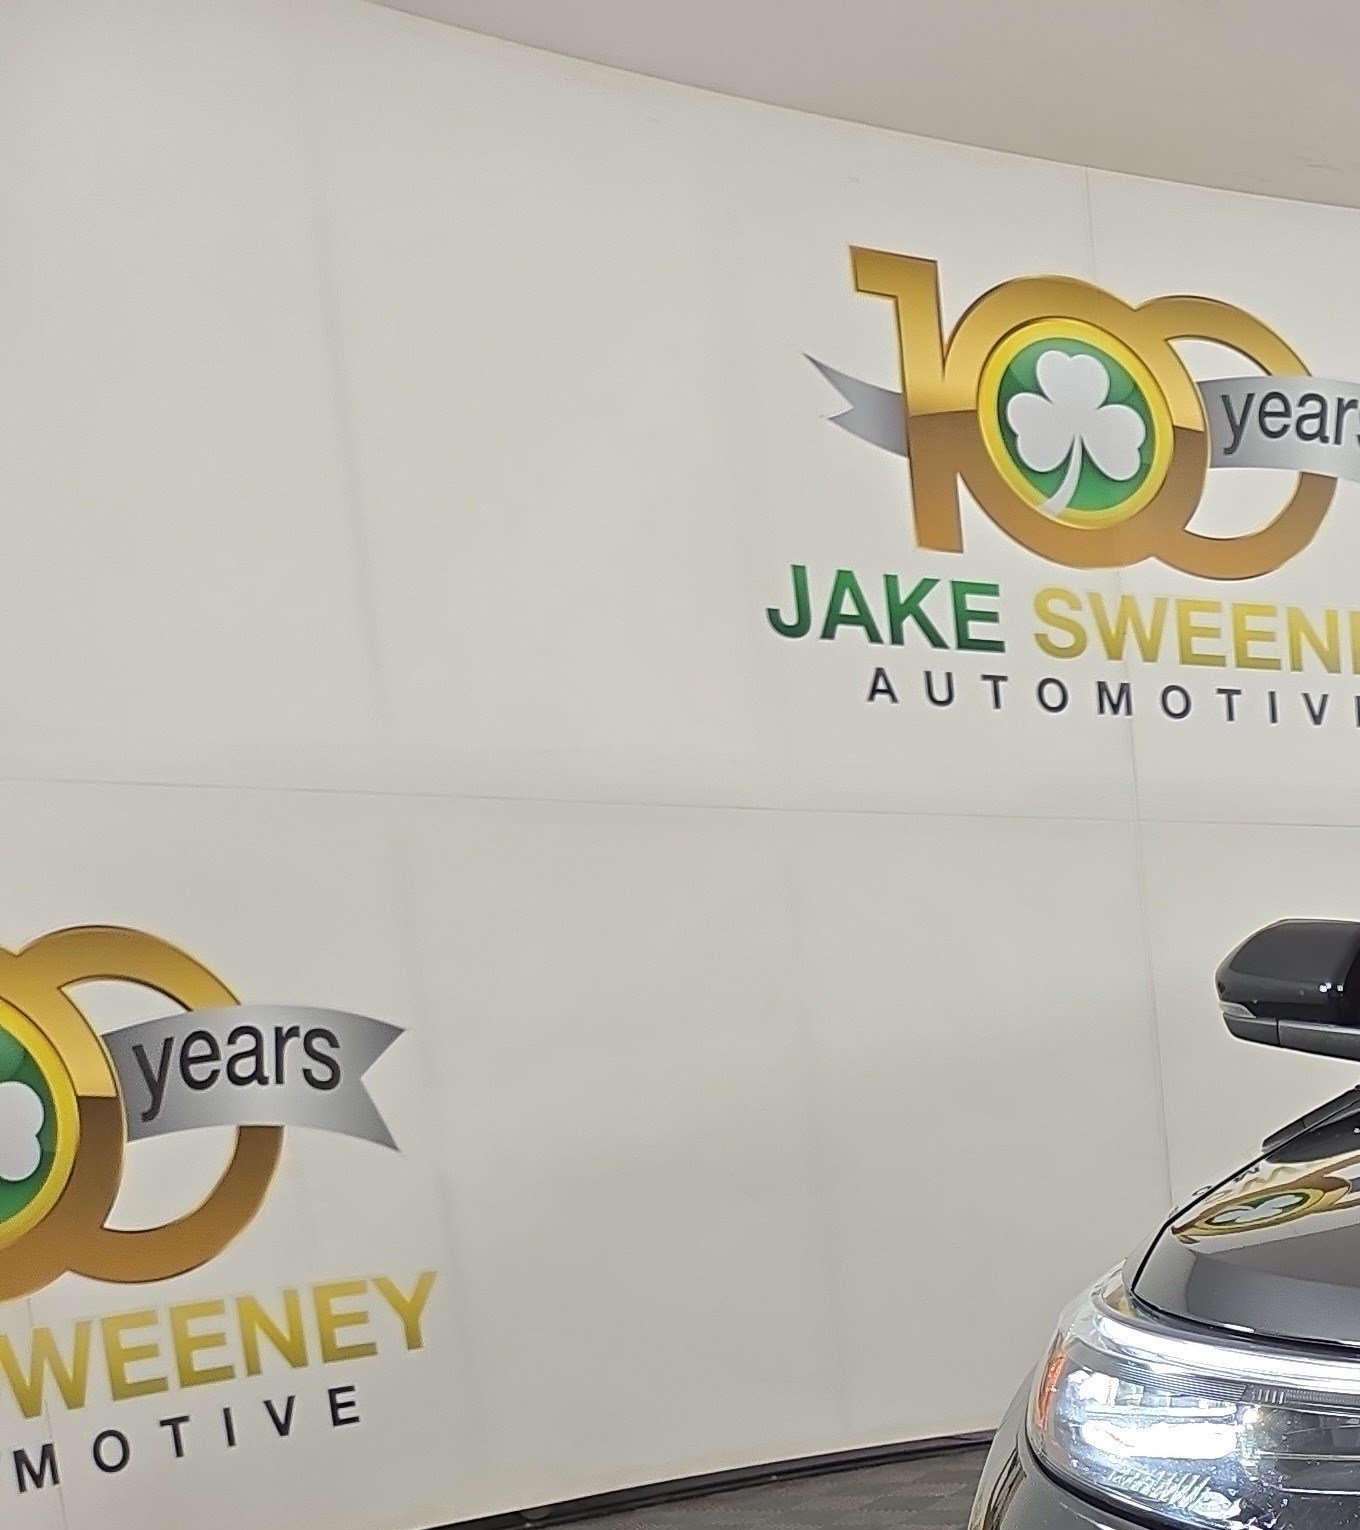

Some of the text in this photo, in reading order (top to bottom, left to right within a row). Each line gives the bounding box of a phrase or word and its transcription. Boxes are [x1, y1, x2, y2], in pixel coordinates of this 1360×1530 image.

[849, 245, 1338, 580] 100
[766, 564, 1005, 654] JAKE
[132, 1024, 341, 1122] years
